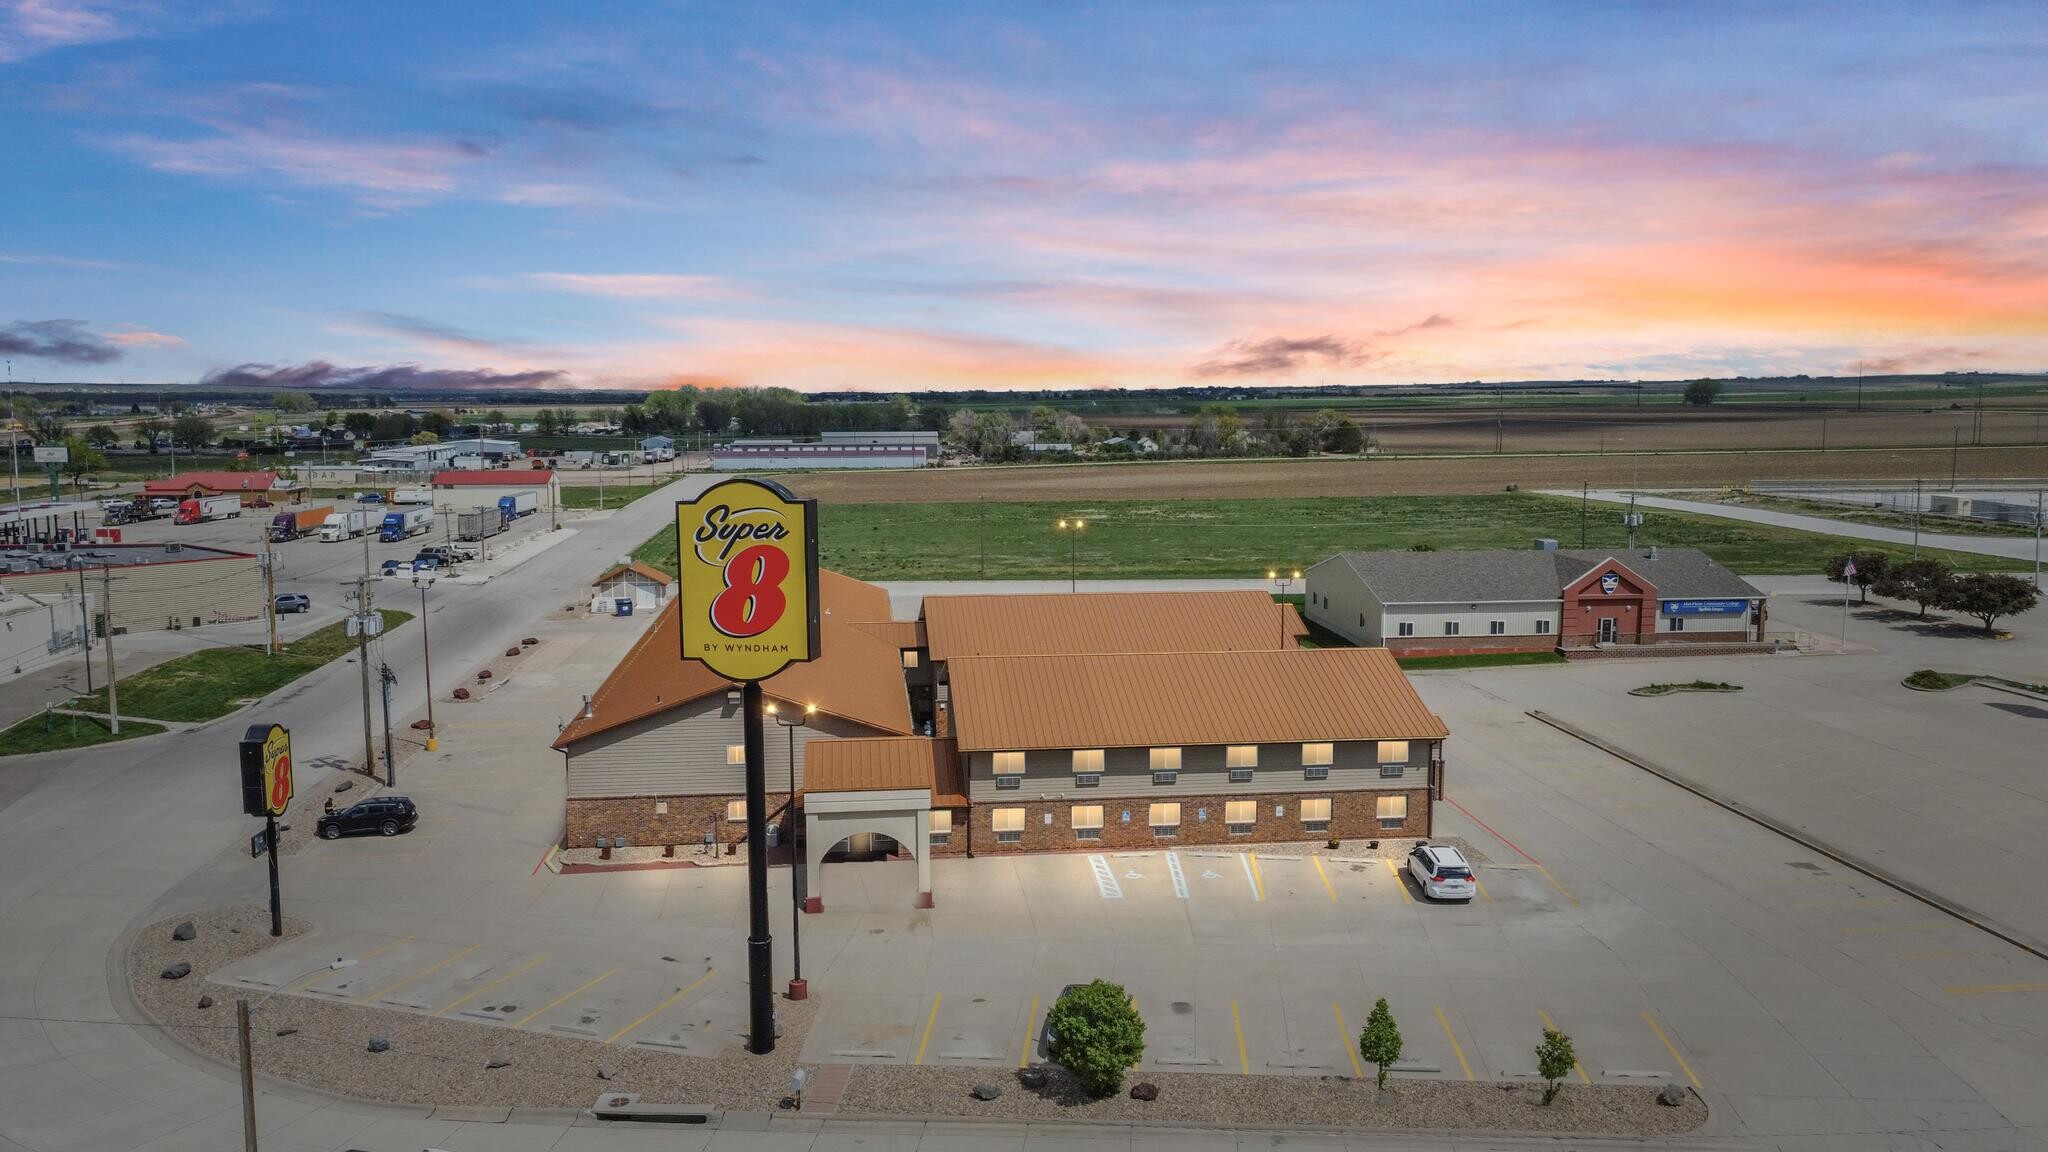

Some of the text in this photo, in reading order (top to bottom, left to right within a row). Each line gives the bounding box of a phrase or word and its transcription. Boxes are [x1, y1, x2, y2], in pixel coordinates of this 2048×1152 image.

[312, 471, 336, 479] BAR
[695, 504, 790, 561] Super
[709, 544, 790, 638] 8
[703, 643, 789, 653] BY WYNDHAM
[265, 740, 289, 770] Super
[271, 755, 290, 810] 8
